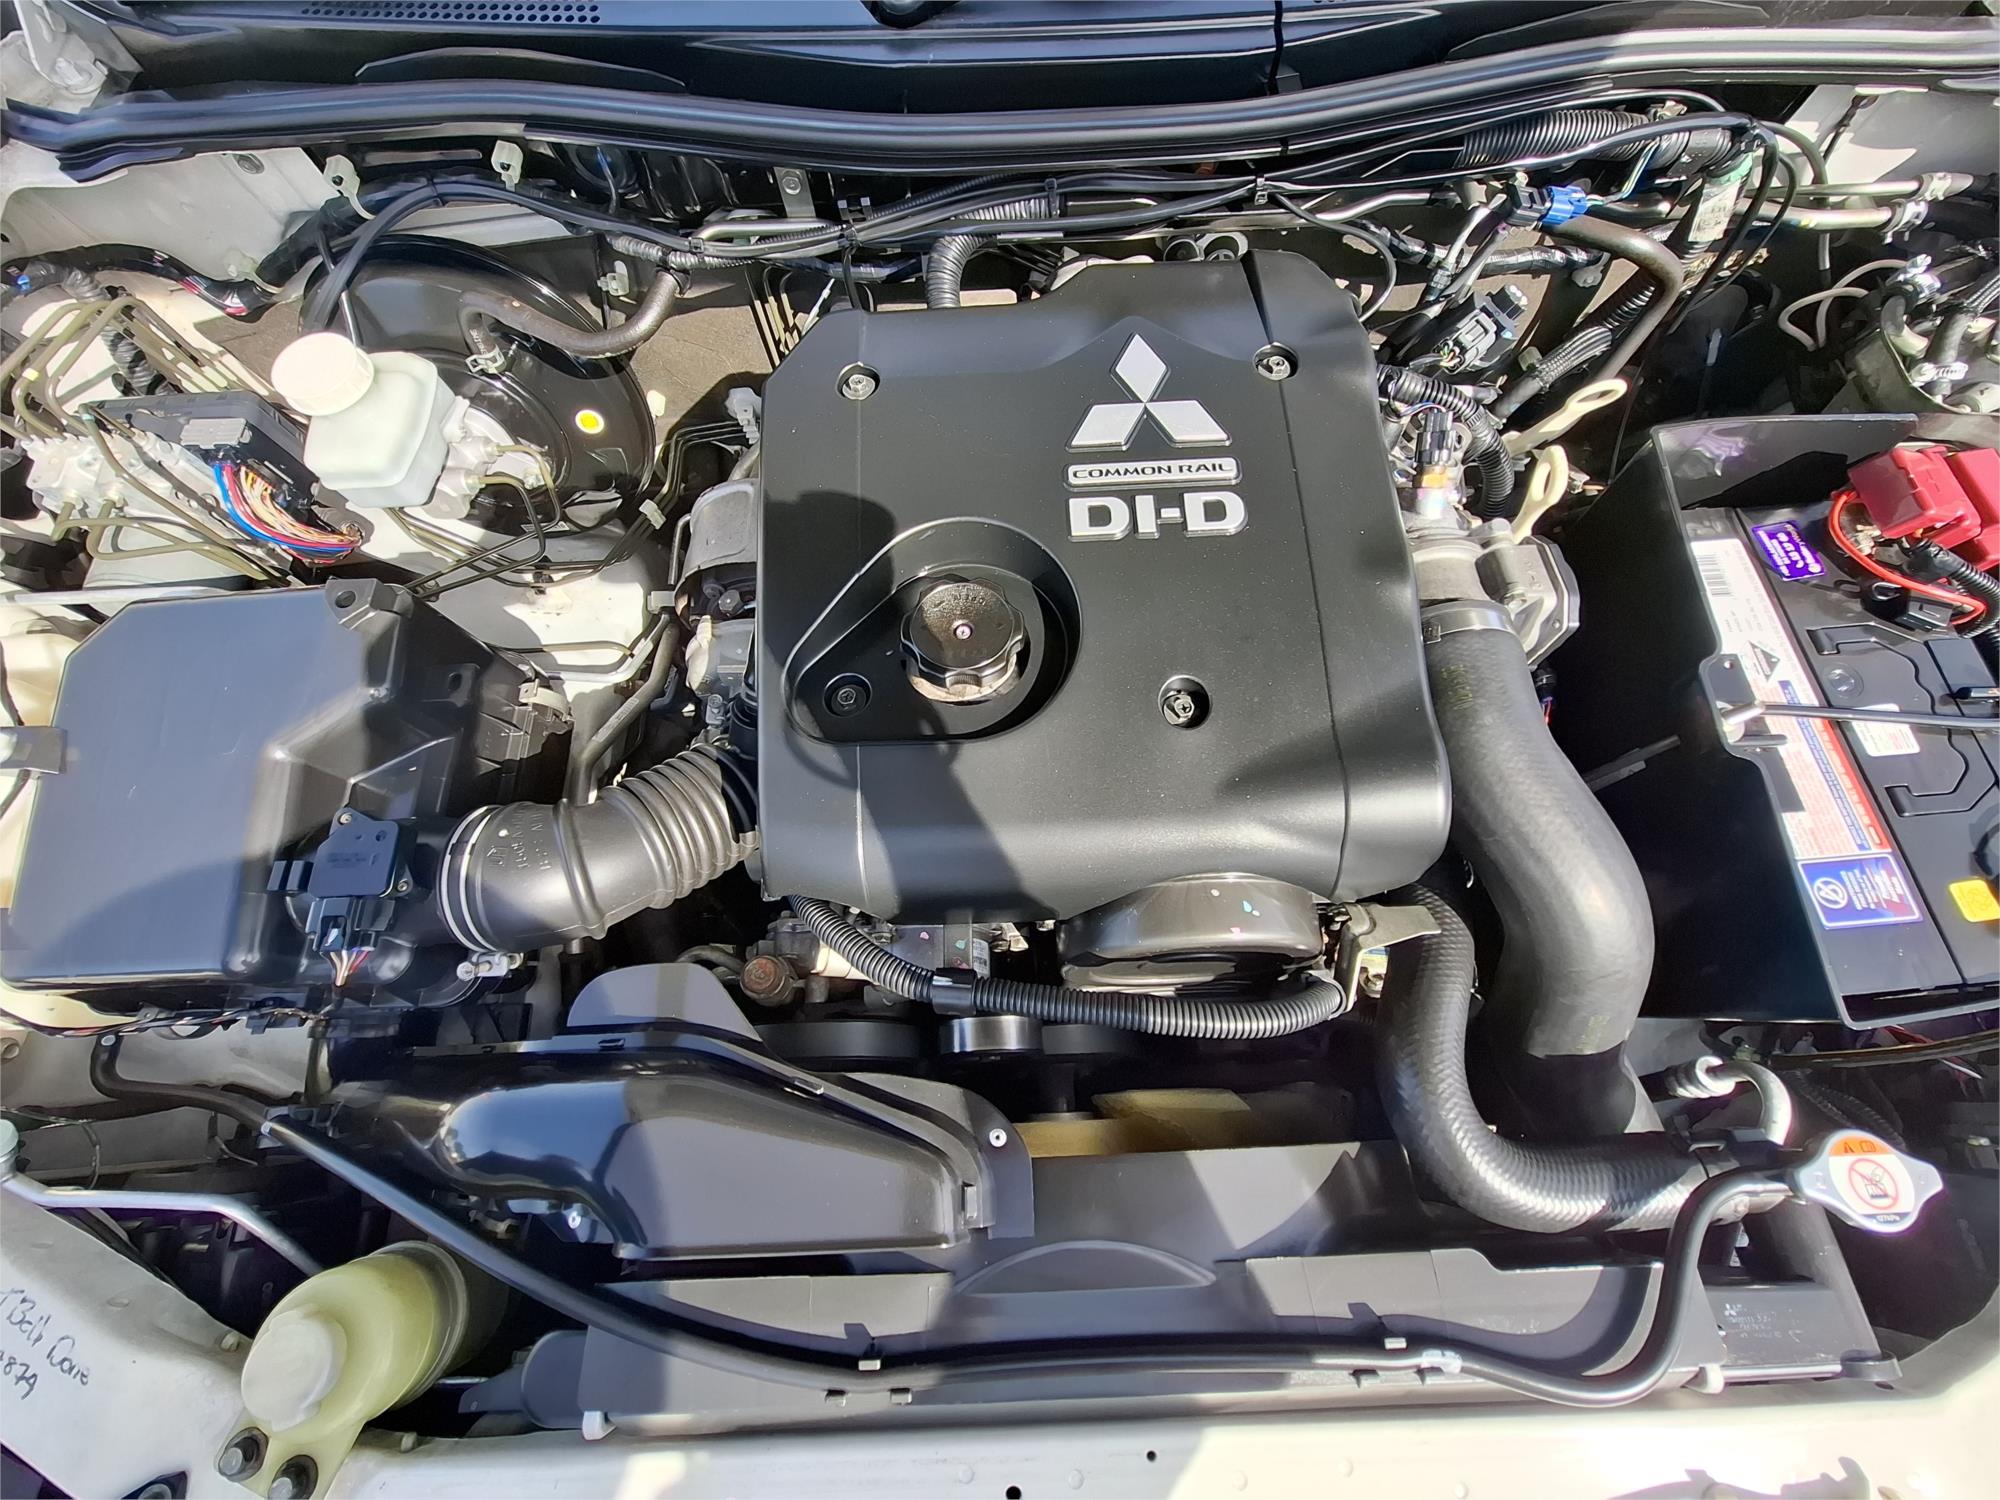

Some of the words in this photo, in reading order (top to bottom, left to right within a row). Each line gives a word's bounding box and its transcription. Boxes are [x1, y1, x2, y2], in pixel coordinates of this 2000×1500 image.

[1072, 464, 1173, 479] COMMON
[1178, 462, 1234, 474] RAIL
[1068, 491, 1247, 541] DI-D
